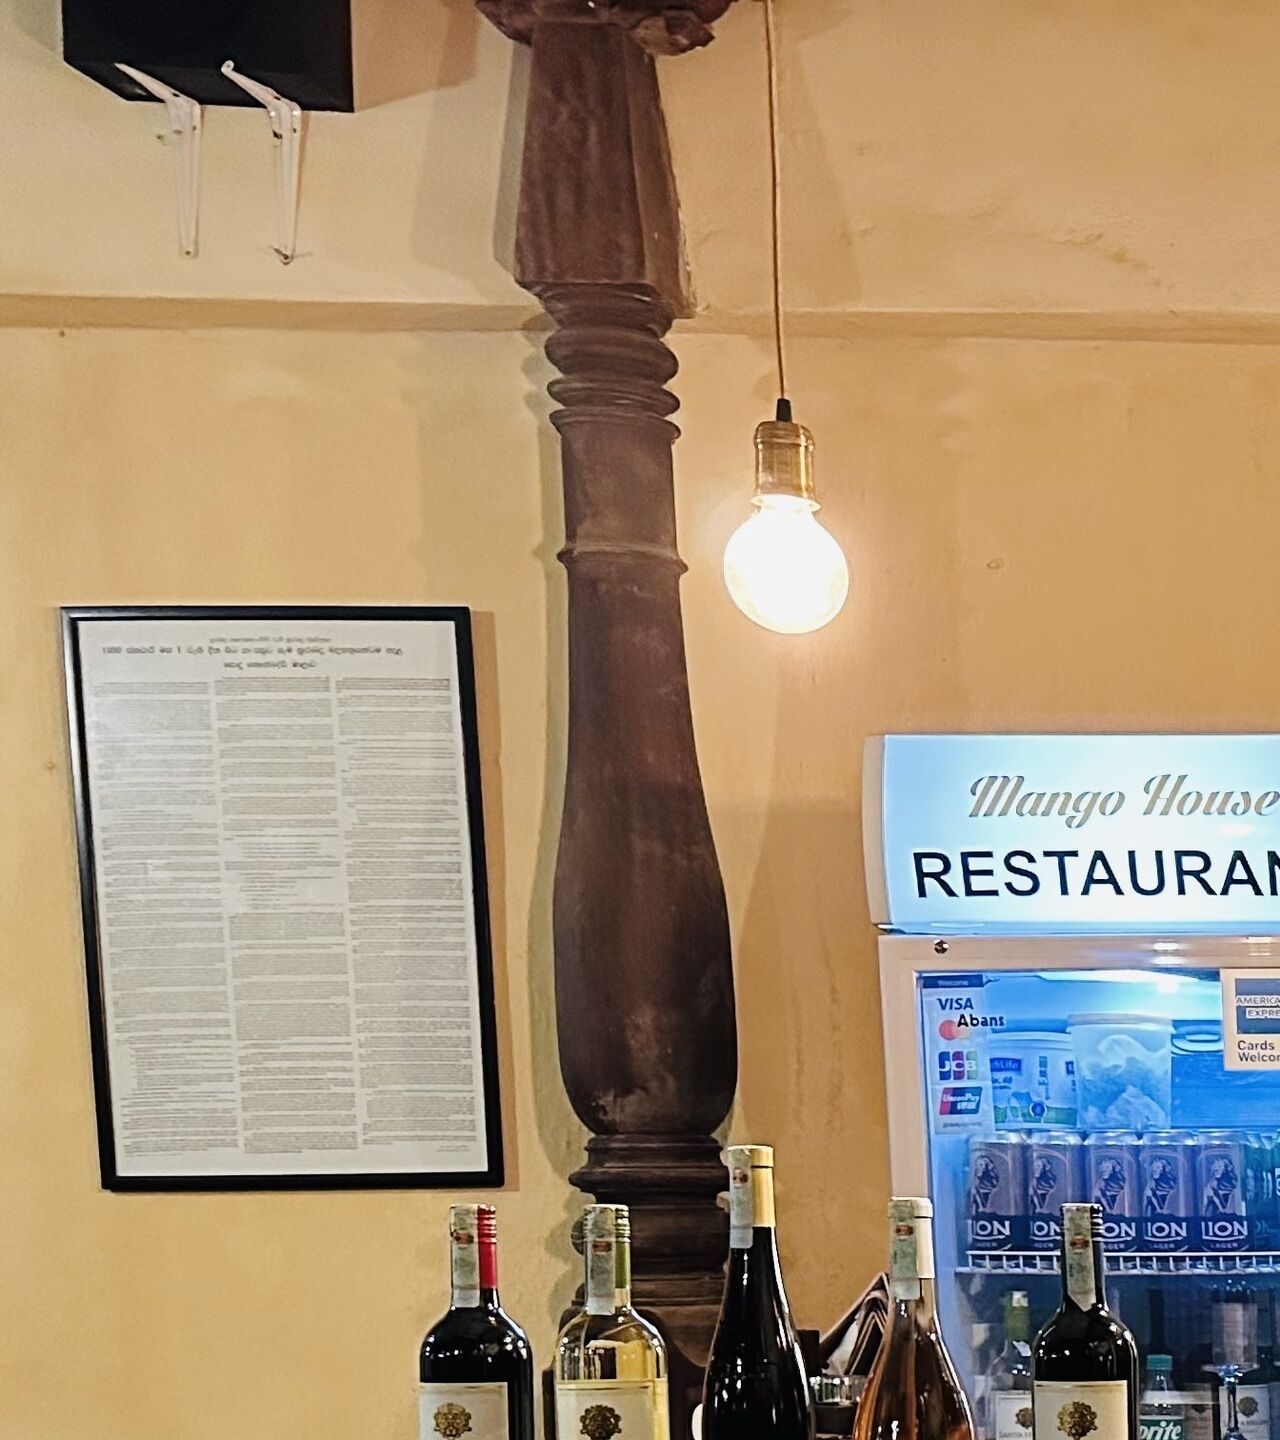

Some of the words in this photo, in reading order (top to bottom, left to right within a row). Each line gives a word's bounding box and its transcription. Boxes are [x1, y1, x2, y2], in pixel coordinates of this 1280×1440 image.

[969, 775, 1126, 829] Mango
[1143, 774, 1280, 817] House
[936, 997, 975, 1011] VISA
[957, 1014, 1006, 1028] Abans
[1237, 1039, 1275, 1050] Cards
[1201, 1220, 1248, 1239] LION
